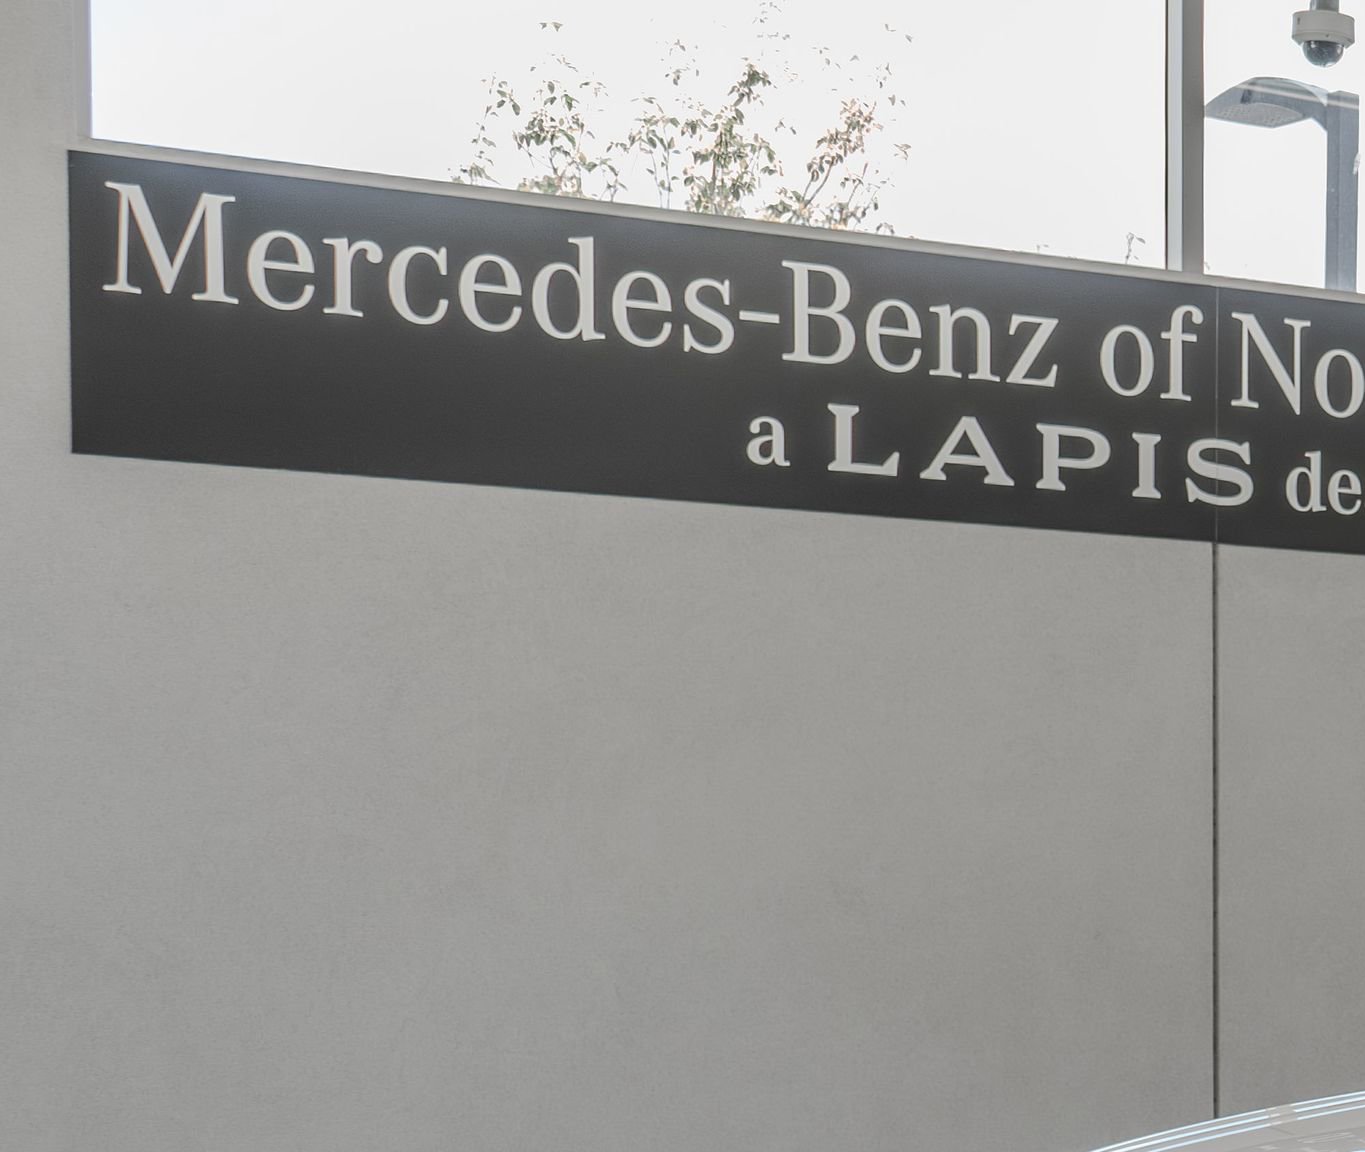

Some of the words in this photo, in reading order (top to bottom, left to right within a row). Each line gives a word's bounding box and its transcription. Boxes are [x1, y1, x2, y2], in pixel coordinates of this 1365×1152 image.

[102, 180, 1061, 389] Mercedes-Benz
[1098, 304, 1204, 402] of
[746, 415, 791, 467] a
[827, 403, 1254, 506] LAPIS
